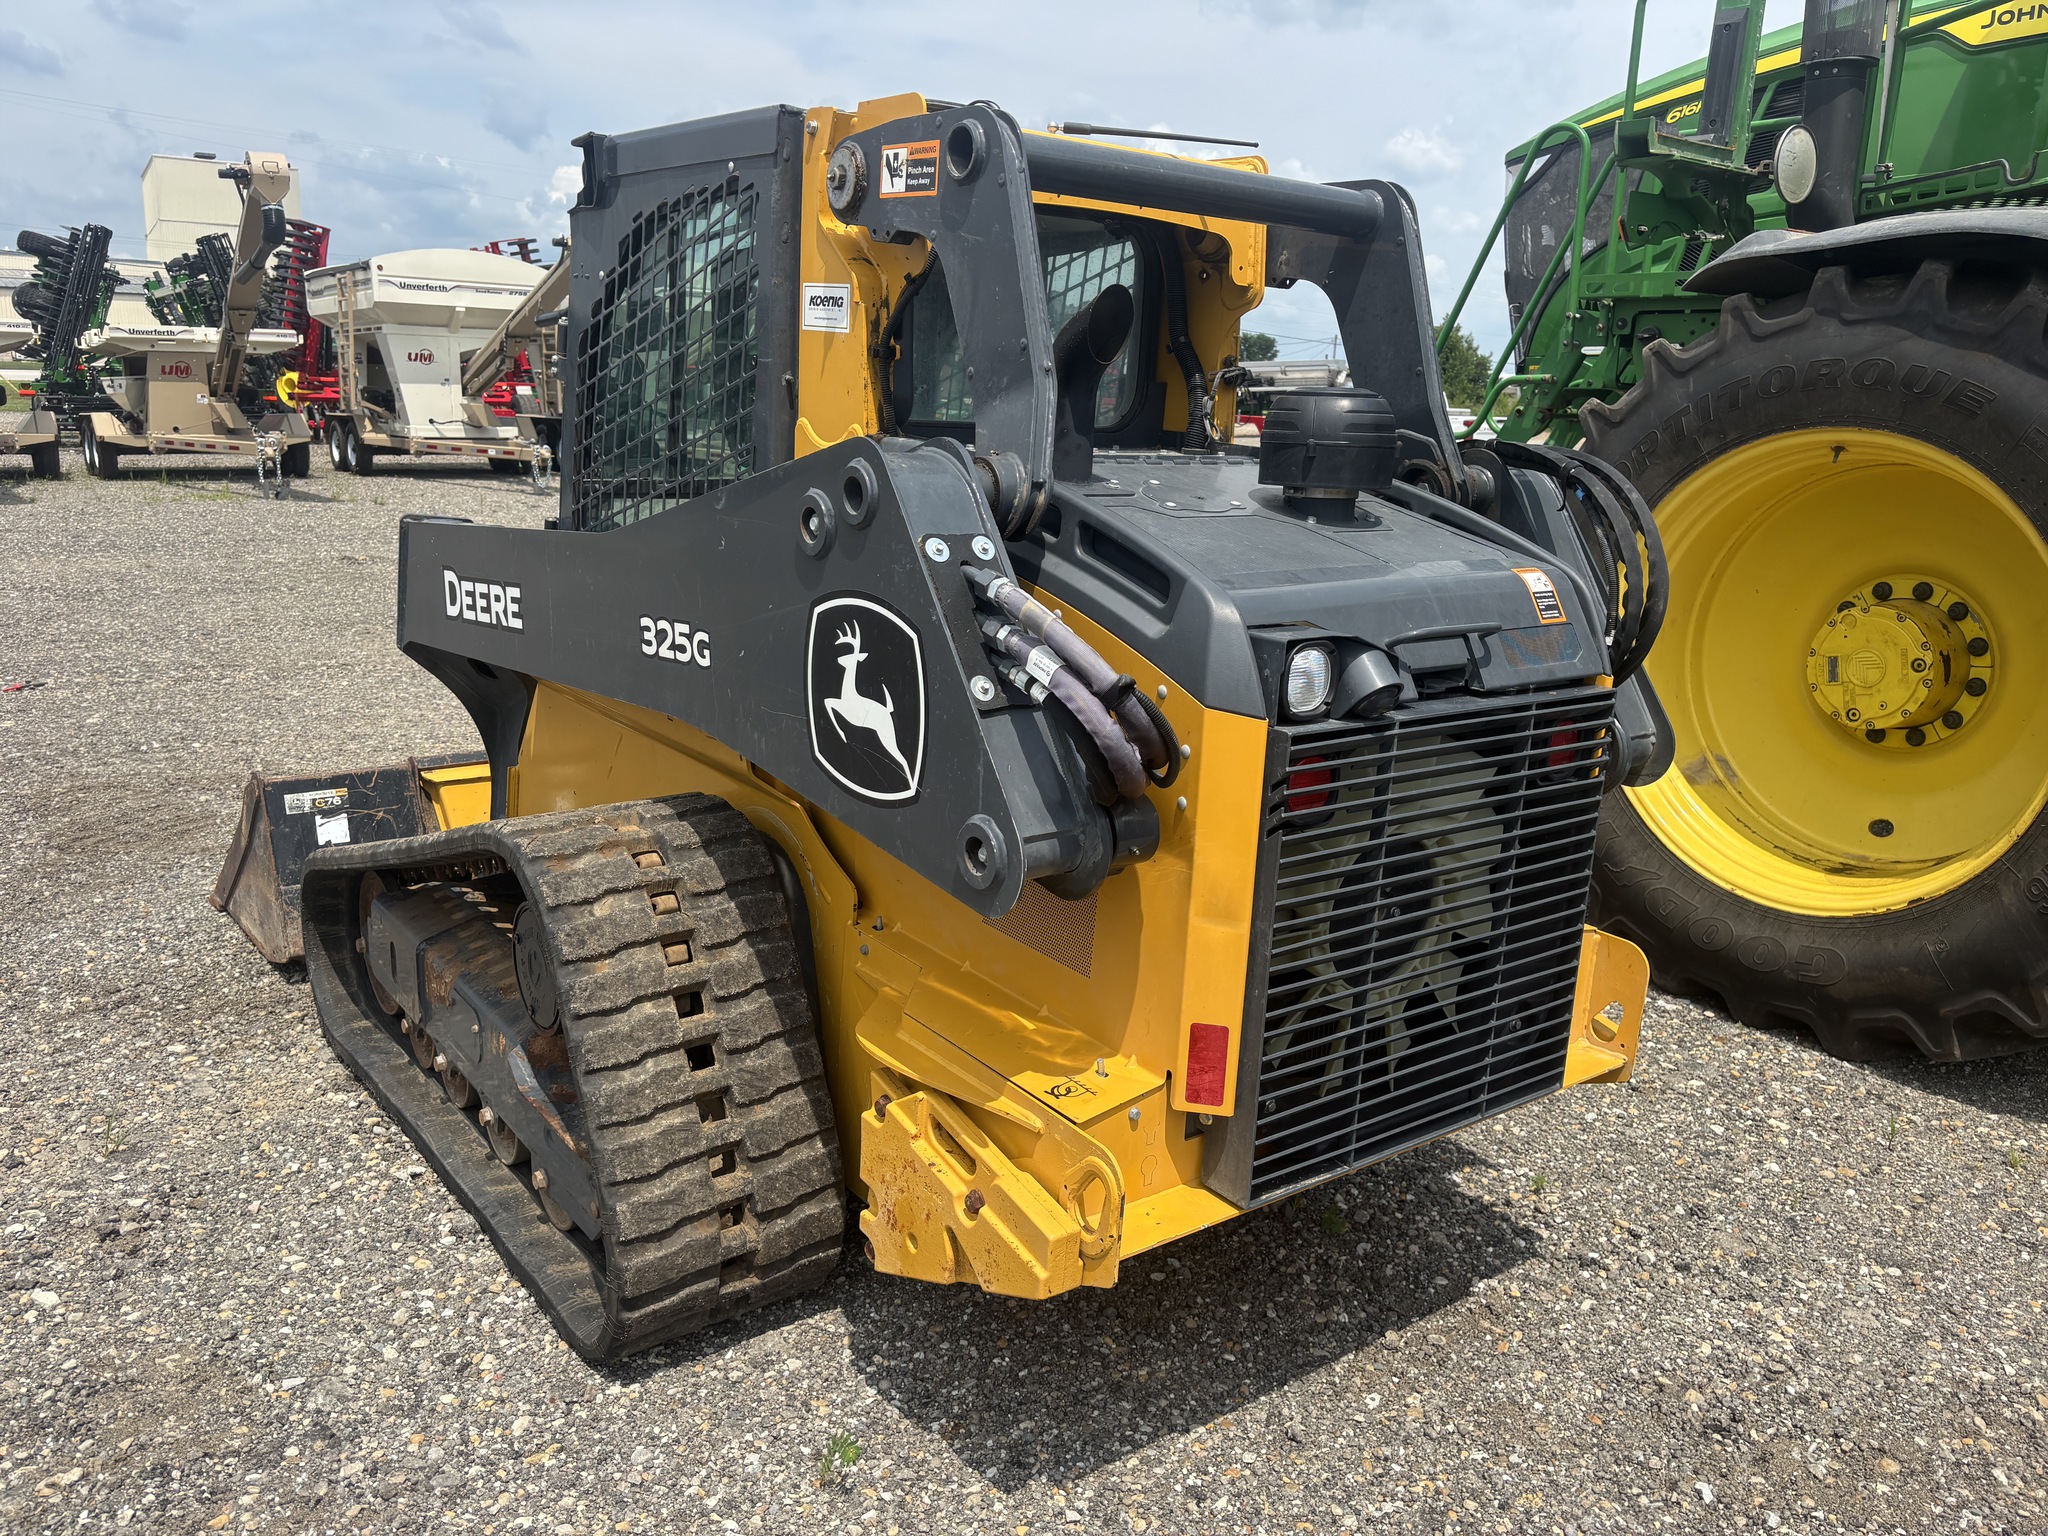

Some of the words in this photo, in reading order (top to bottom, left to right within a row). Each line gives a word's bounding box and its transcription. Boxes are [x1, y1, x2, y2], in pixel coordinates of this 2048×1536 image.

[1981, 4, 2048, 29] JOHN
[907, 166, 921, 174] Pinch
[922, 165, 934, 174] Area
[907, 178, 918, 186] Keep
[919, 177, 931, 186] Away
[399, 281, 448, 292] Unverferth
[128, 327, 176, 336] Unverferth
[443, 569, 524, 630] DEERE
[639, 616, 711, 668] 325G
